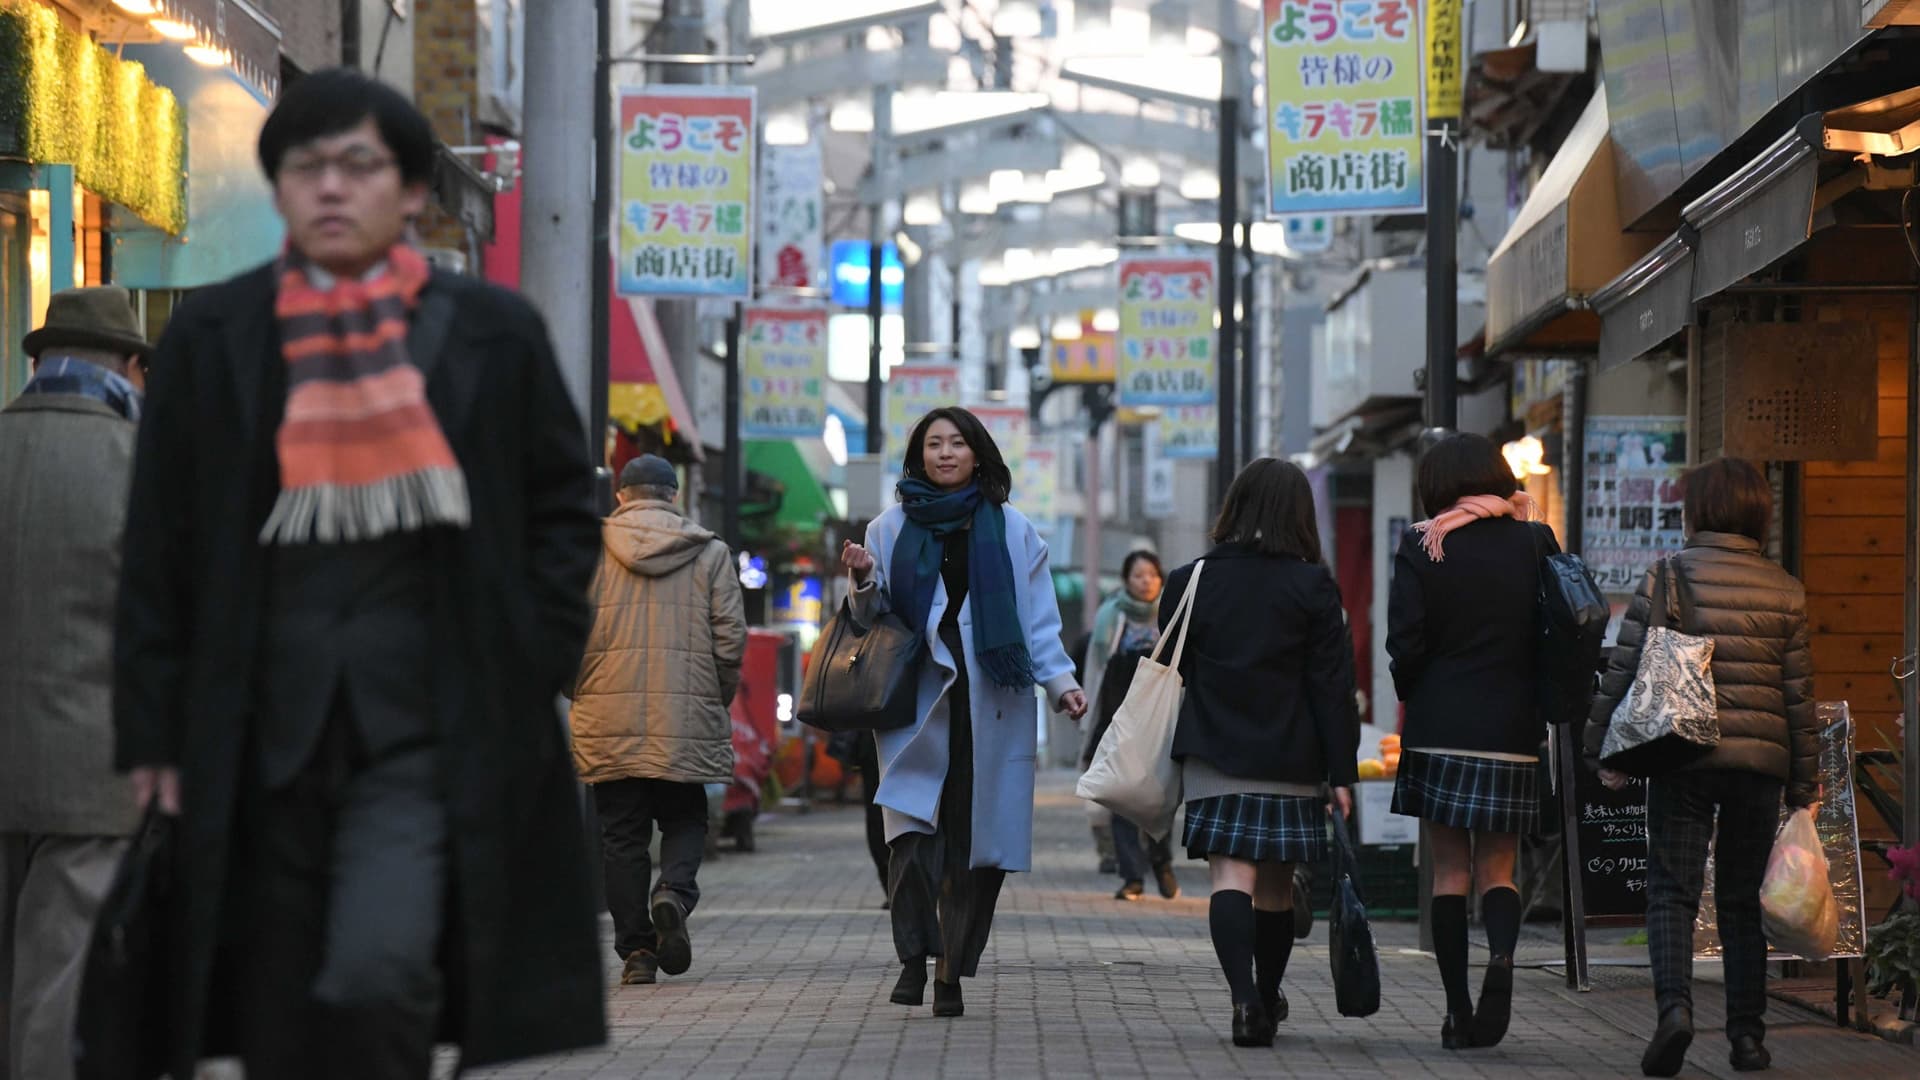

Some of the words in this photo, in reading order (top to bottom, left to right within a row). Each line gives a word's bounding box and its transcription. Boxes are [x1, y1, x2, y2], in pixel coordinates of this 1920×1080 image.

[1274, 2, 1409, 41] ようこそ
[1300, 54, 1393, 86] 皆様の
[627, 116, 743, 151] ようこそ
[648, 162, 728, 188] 皆様の
[1289, 151, 1407, 193] 商店街
[635, 247, 734, 278] 商店街
[1126, 276, 1204, 300] ようこそ
